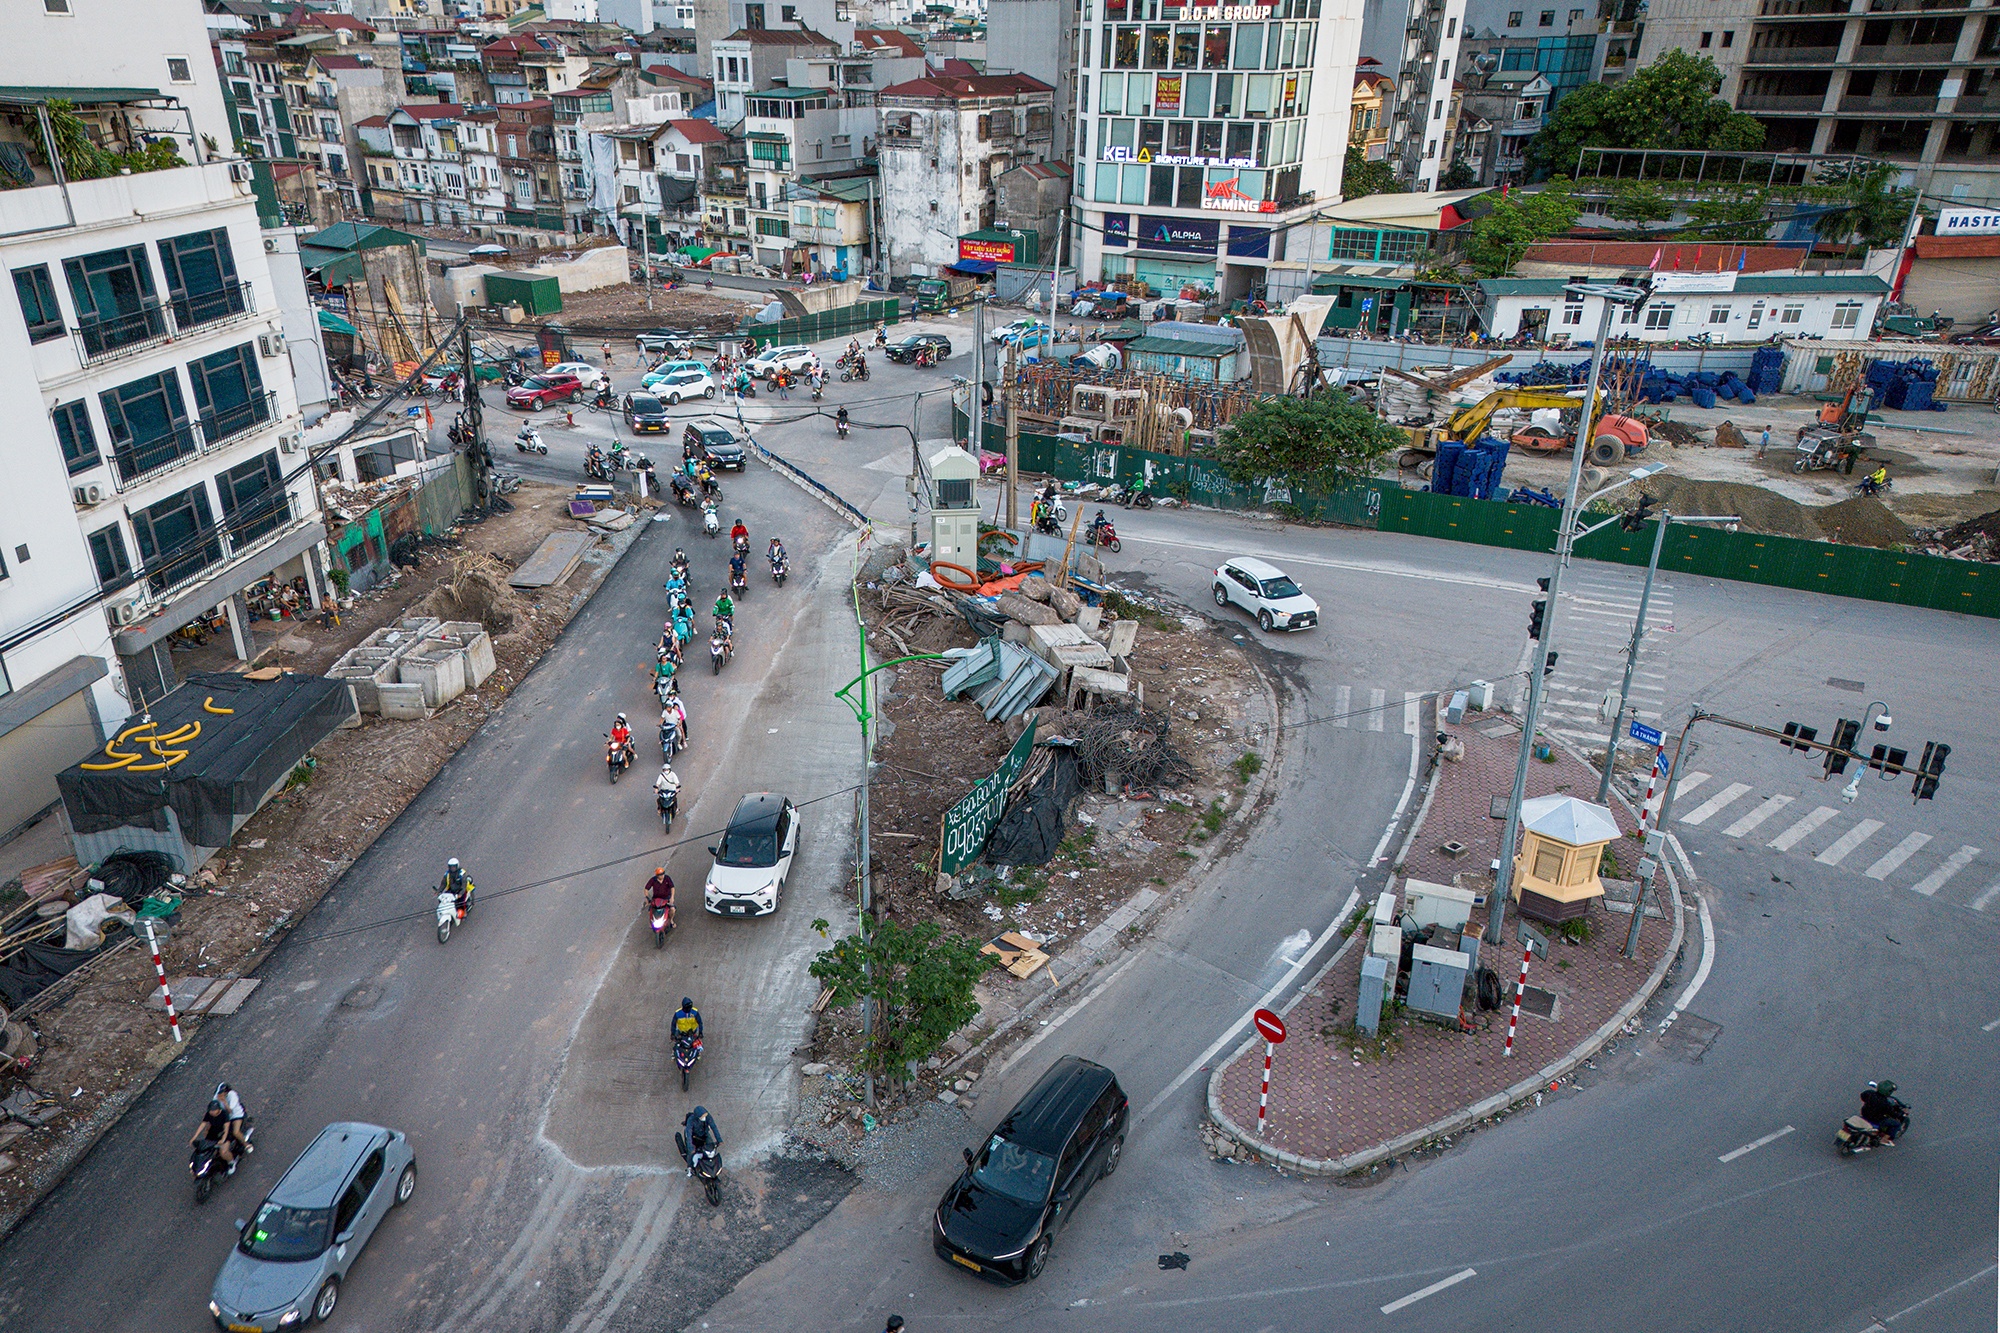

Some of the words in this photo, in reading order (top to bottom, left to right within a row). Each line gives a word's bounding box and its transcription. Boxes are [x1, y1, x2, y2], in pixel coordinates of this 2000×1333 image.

[1180, 6, 1218, 20] D.O.M
[1224, 5, 1272, 20] GROUP
[1155, 154, 1205, 165] SIGNATURE
[1208, 156, 1258, 168] BILLIARDS
[1202, 198, 1260, 212] GAMING
[1172, 230, 1202, 240] ALPHA
